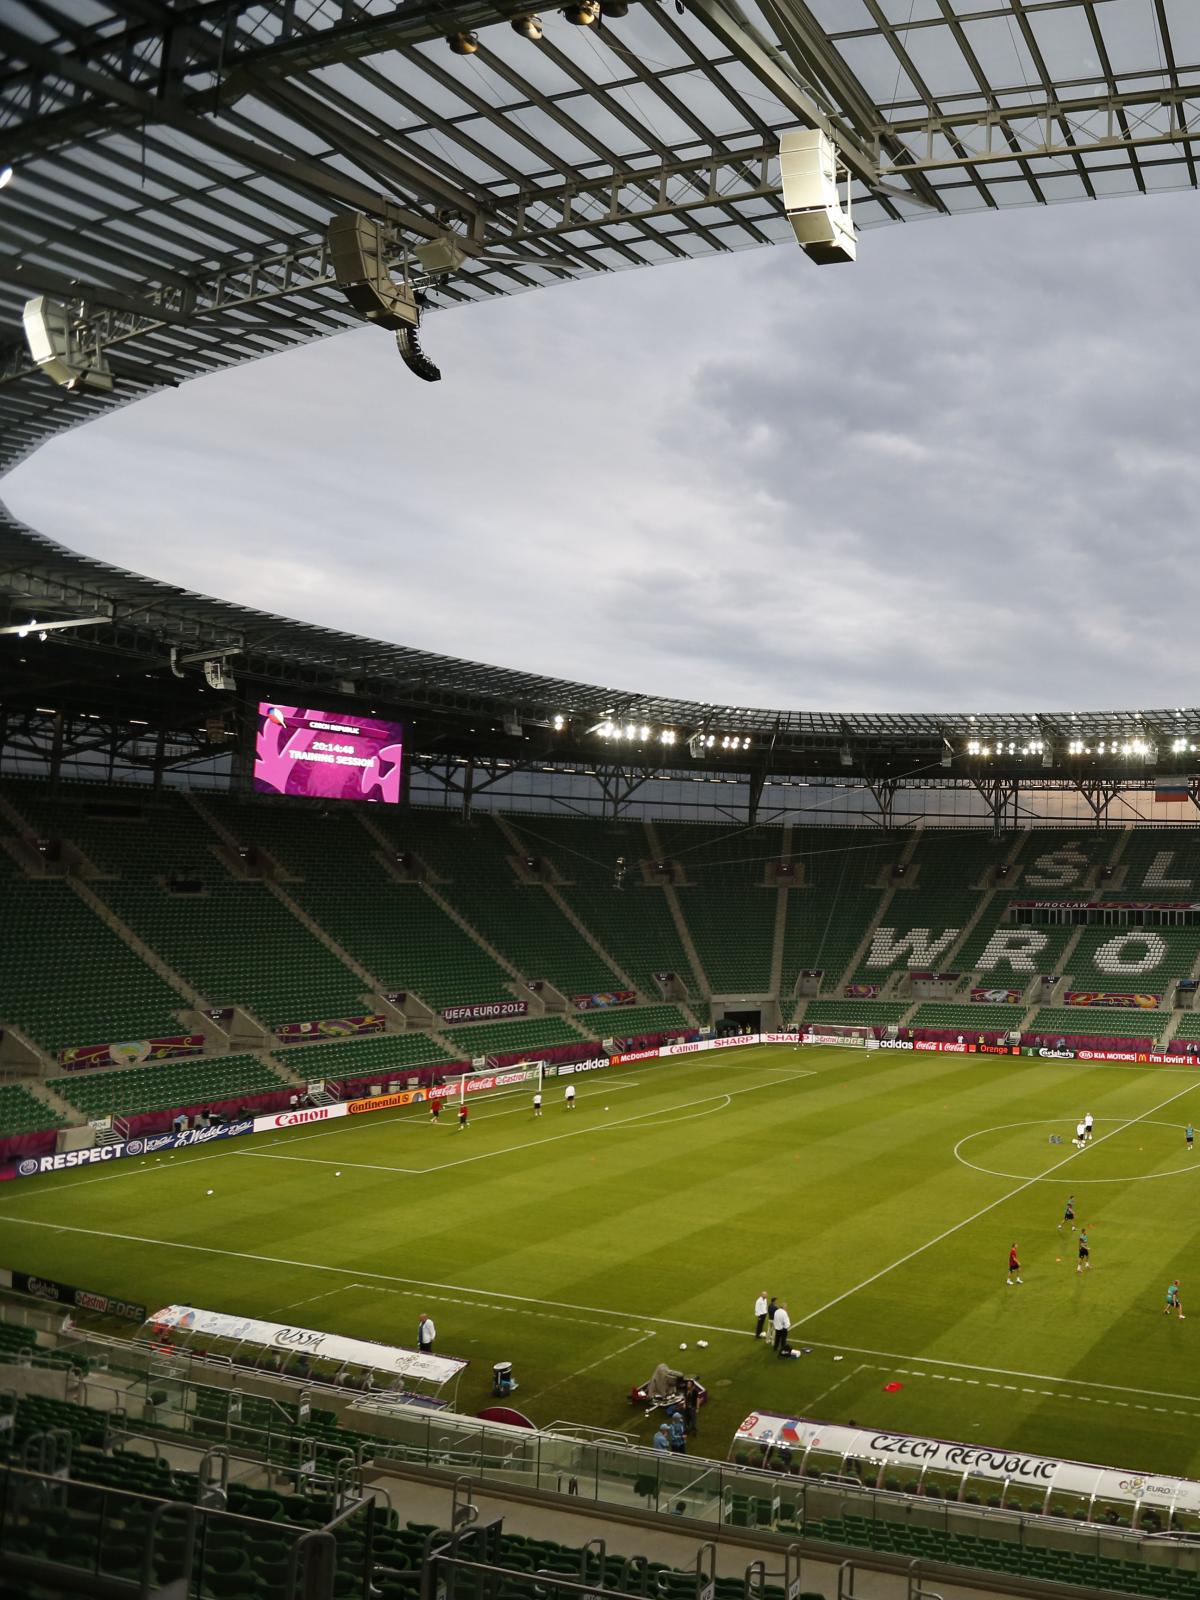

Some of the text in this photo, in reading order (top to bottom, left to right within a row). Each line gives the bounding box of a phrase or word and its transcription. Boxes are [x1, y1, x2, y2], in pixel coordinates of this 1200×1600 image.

[288, 749, 374, 767] TRAINING SESSION
[444, 1002, 525, 1020] UEFA EURO 2012
[669, 1043, 699, 1054] Canon
[714, 1036, 754, 1047] SHARP
[880, 1040, 914, 1050] adidas
[620, 1049, 659, 1063] McDonald's
[980, 1044, 1008, 1054] Orange
[1039, 1048, 1074, 1059] Carlsberg
[1107, 1053, 1135, 1061] MOTORS
[1187, 1056, 1193, 1064] it
[575, 1057, 610, 1073] adidas
[348, 1094, 401, 1114] Continental
[274, 1108, 329, 1126] Canon
[40, 1145, 125, 1172] RESPECT
[870, 1434, 939, 1459] CZECH
